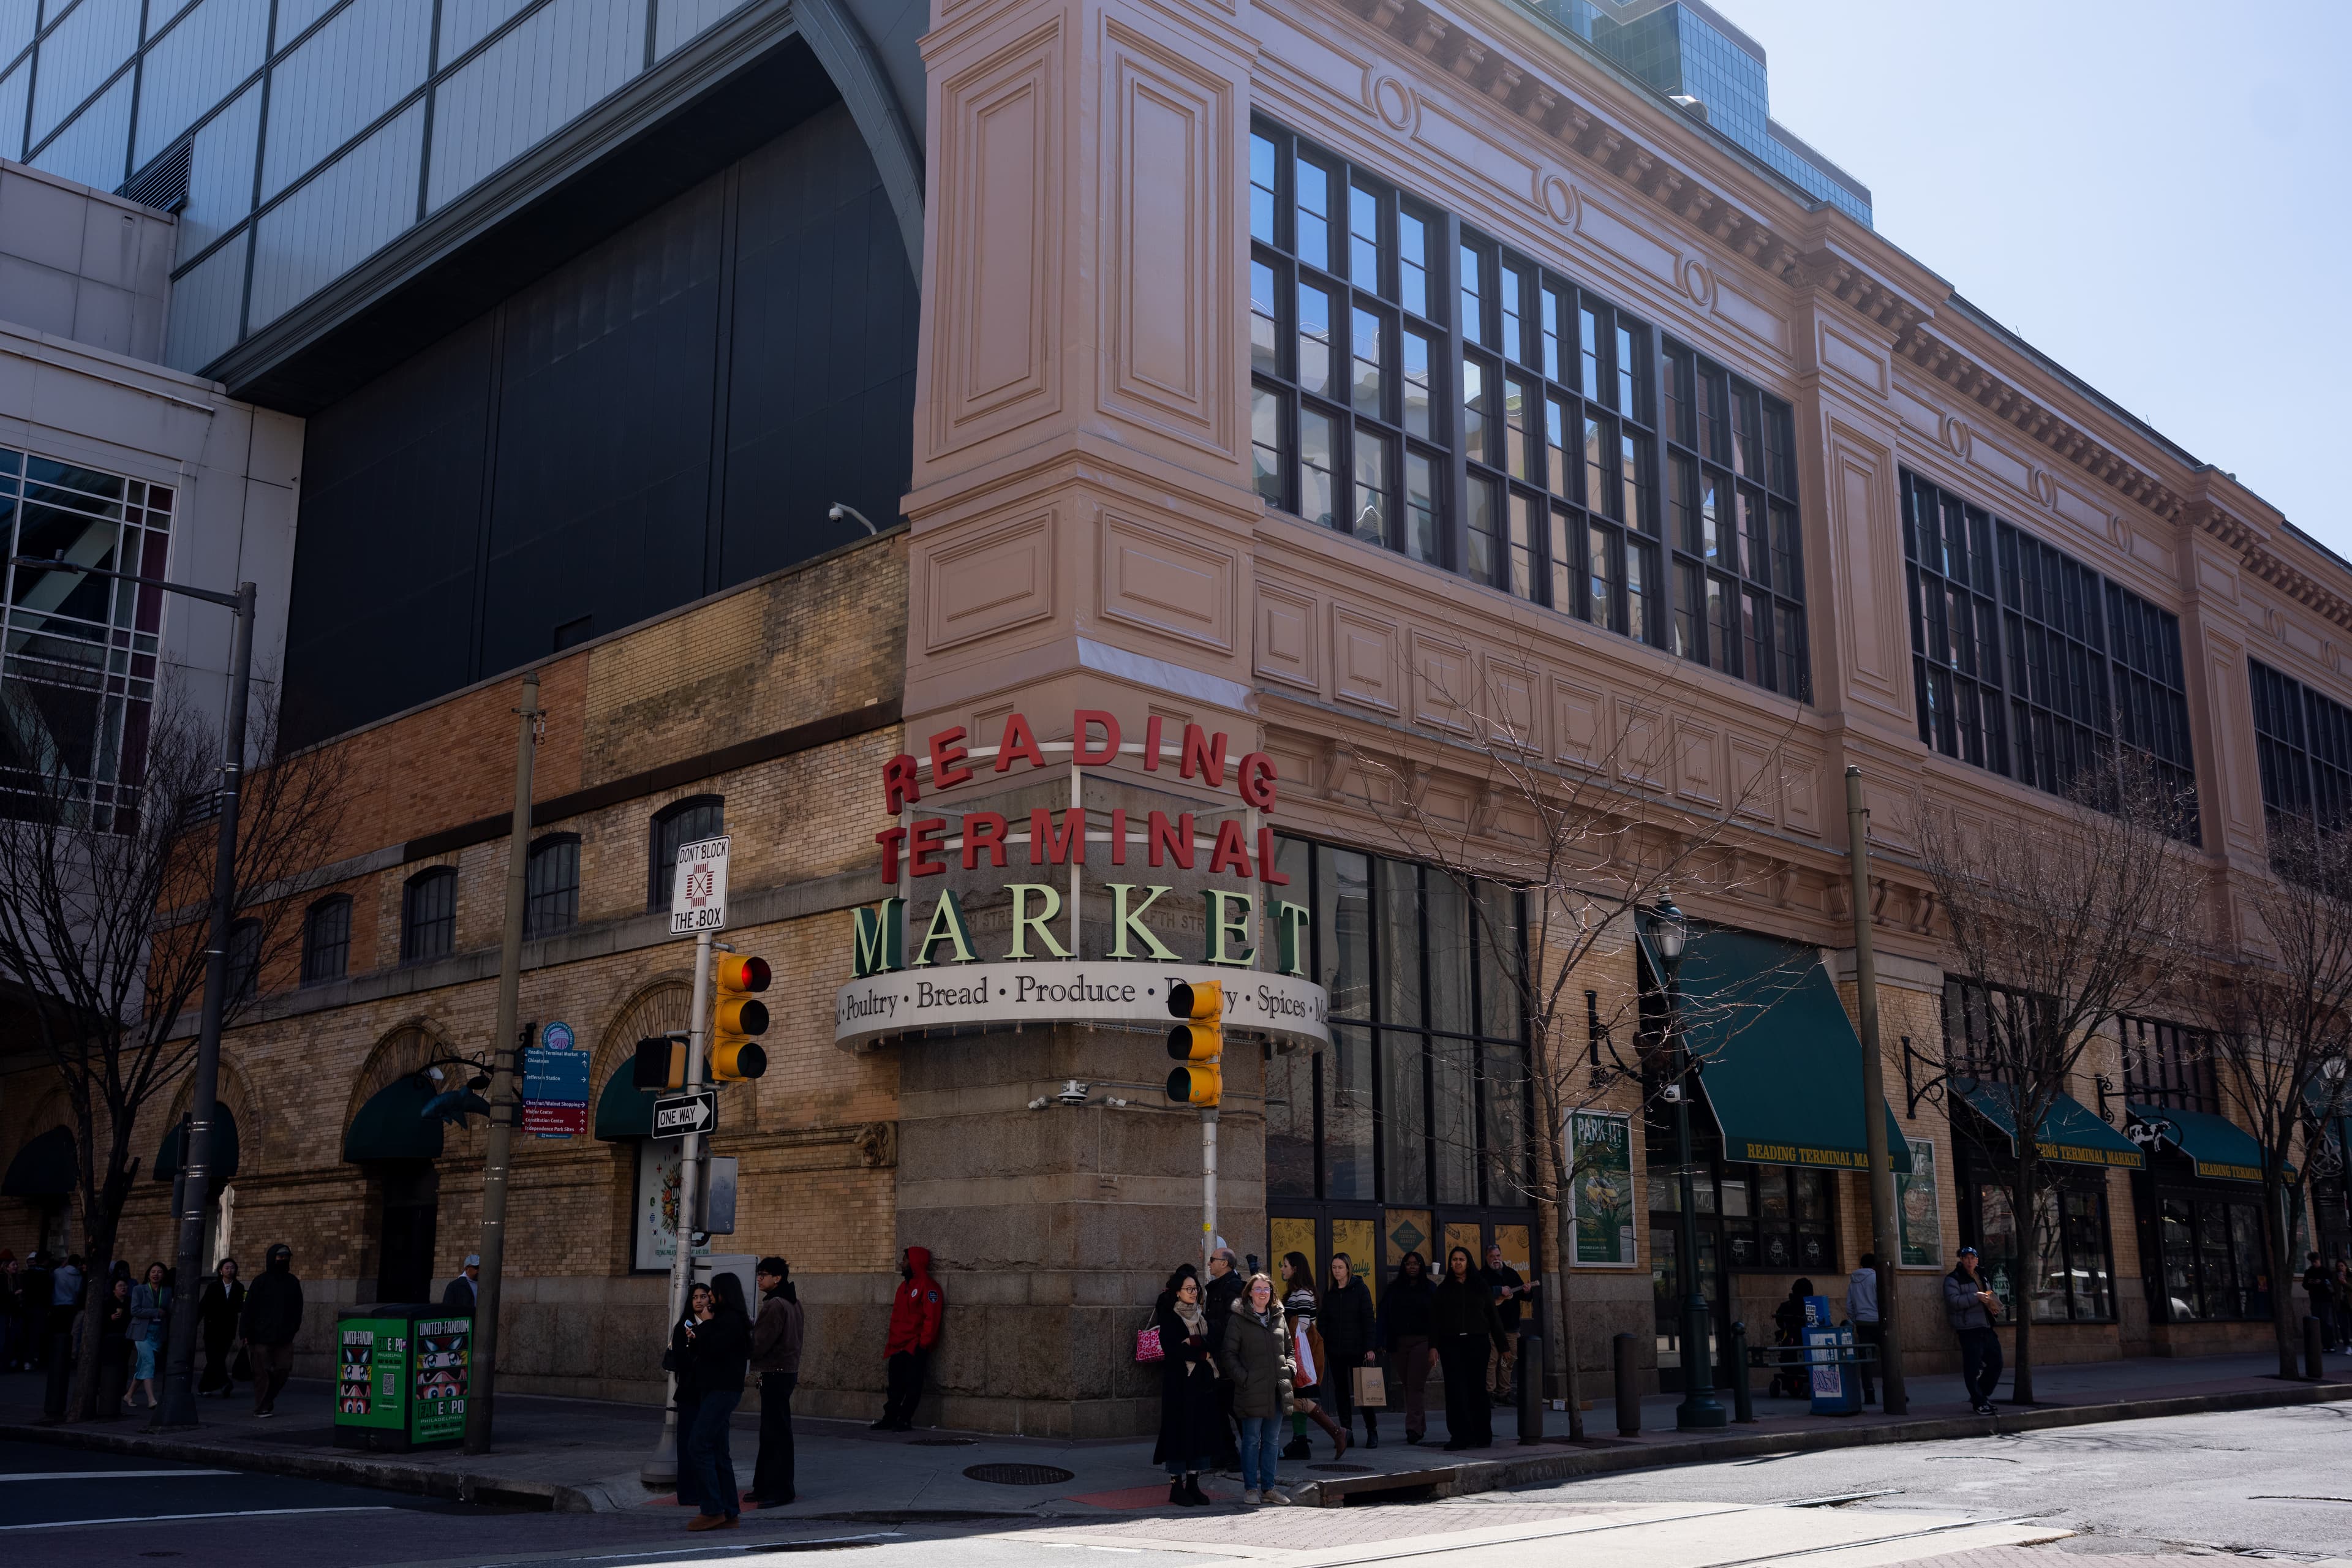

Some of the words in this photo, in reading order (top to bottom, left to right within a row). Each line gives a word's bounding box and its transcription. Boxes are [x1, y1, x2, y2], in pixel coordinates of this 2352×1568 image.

[883, 709, 1278, 815] READING
[701, 841, 727, 859] BLOCK
[875, 808, 1289, 886] TERMINAL
[675, 911, 694, 930] THE
[699, 908, 721, 927] BOX
[850, 884, 1310, 978] MARKET
[846, 989, 898, 1020] Poultry
[917, 976, 989, 1008] Bread
[1015, 974, 1136, 1003] Produce
[1257, 985, 1306, 1019] Spices
[660, 1110, 676, 1126] ONE
[679, 1107, 696, 1123] WAY
[1577, 1117, 1605, 1142] PARK
[1608, 1120, 1622, 1144] IT!
[1746, 1143, 1796, 1163] READING
[1798, 1148, 1852, 1167] TERMINAL
[1853, 1152, 1894, 1170] MAT
[2059, 1145, 2105, 1164] TERMINAL
[2106, 1151, 2141, 1167] MARKET
[2199, 1162, 2231, 1177] READING
[2231, 1166, 2264, 1181] TERMINA
[419, 1322, 441, 1336] UNITED
[444, 1320, 469, 1334] FANDOM
[421, 1415, 462, 1424] PHILADELPHIA
